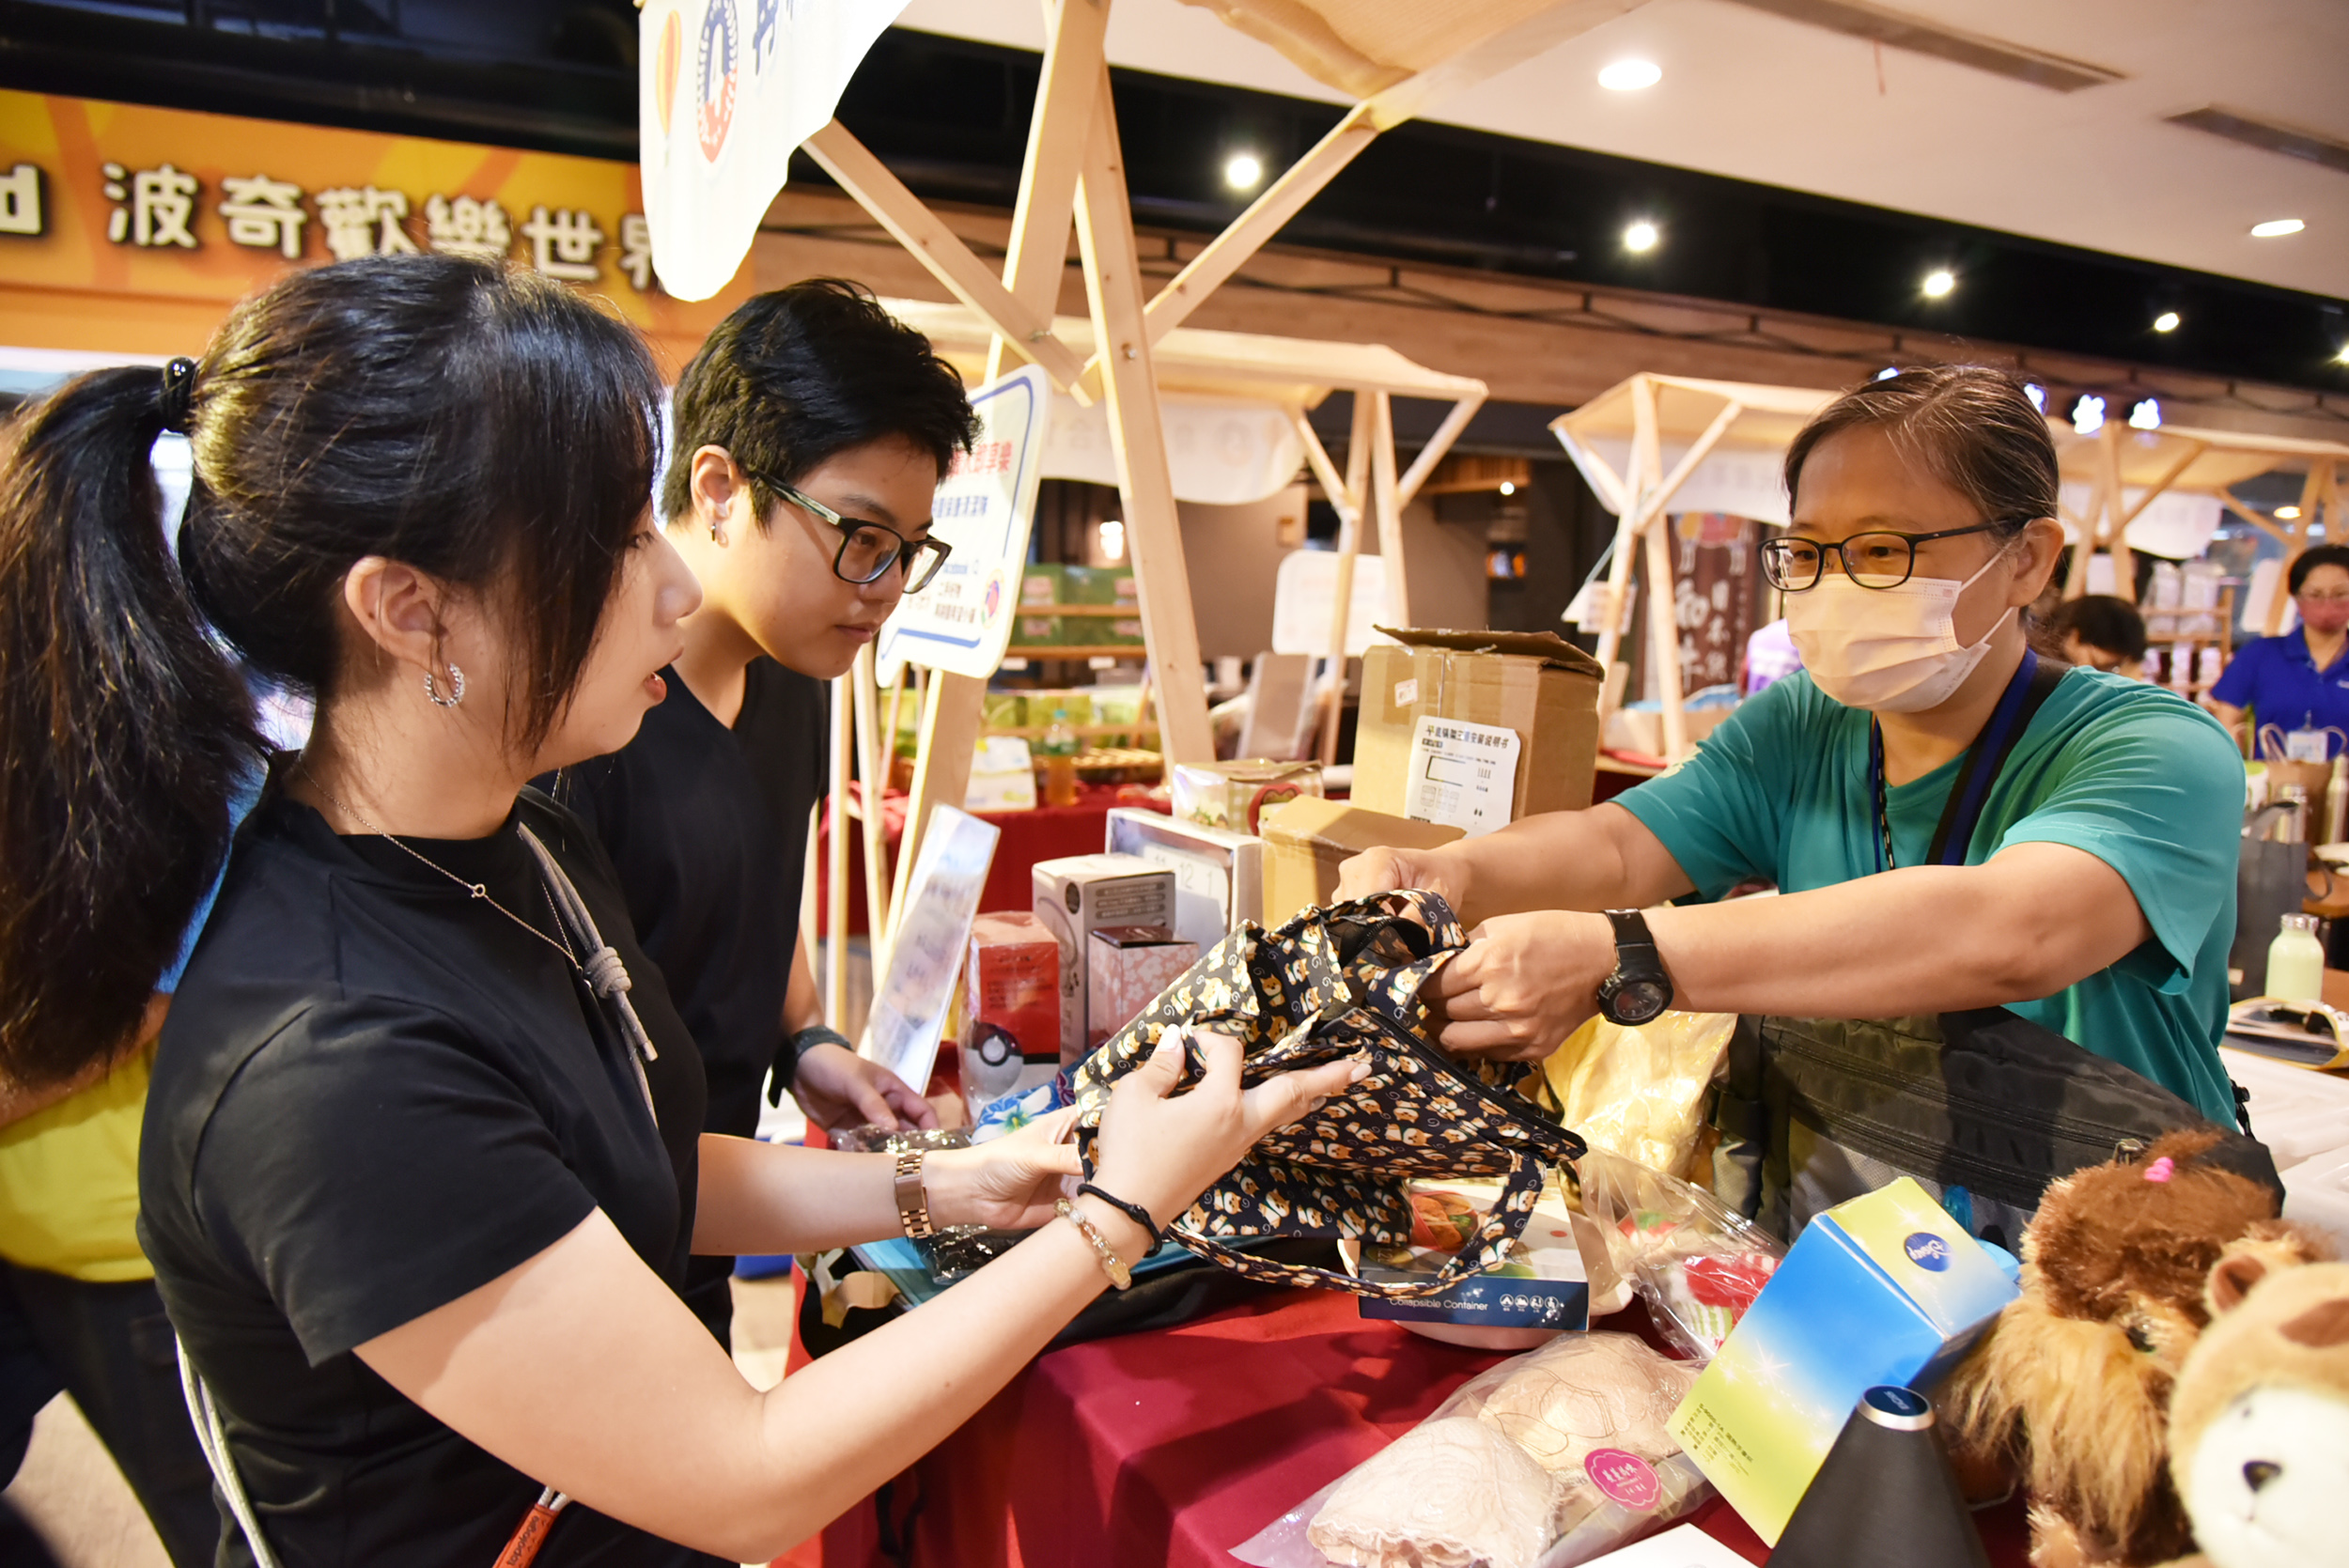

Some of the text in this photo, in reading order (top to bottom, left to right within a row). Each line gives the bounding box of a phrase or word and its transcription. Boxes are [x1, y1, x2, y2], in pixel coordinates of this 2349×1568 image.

[1179, 862, 1194, 890] 12
[1390, 1297, 1442, 1309] Collapsible
[1443, 1299, 1488, 1311] Container
